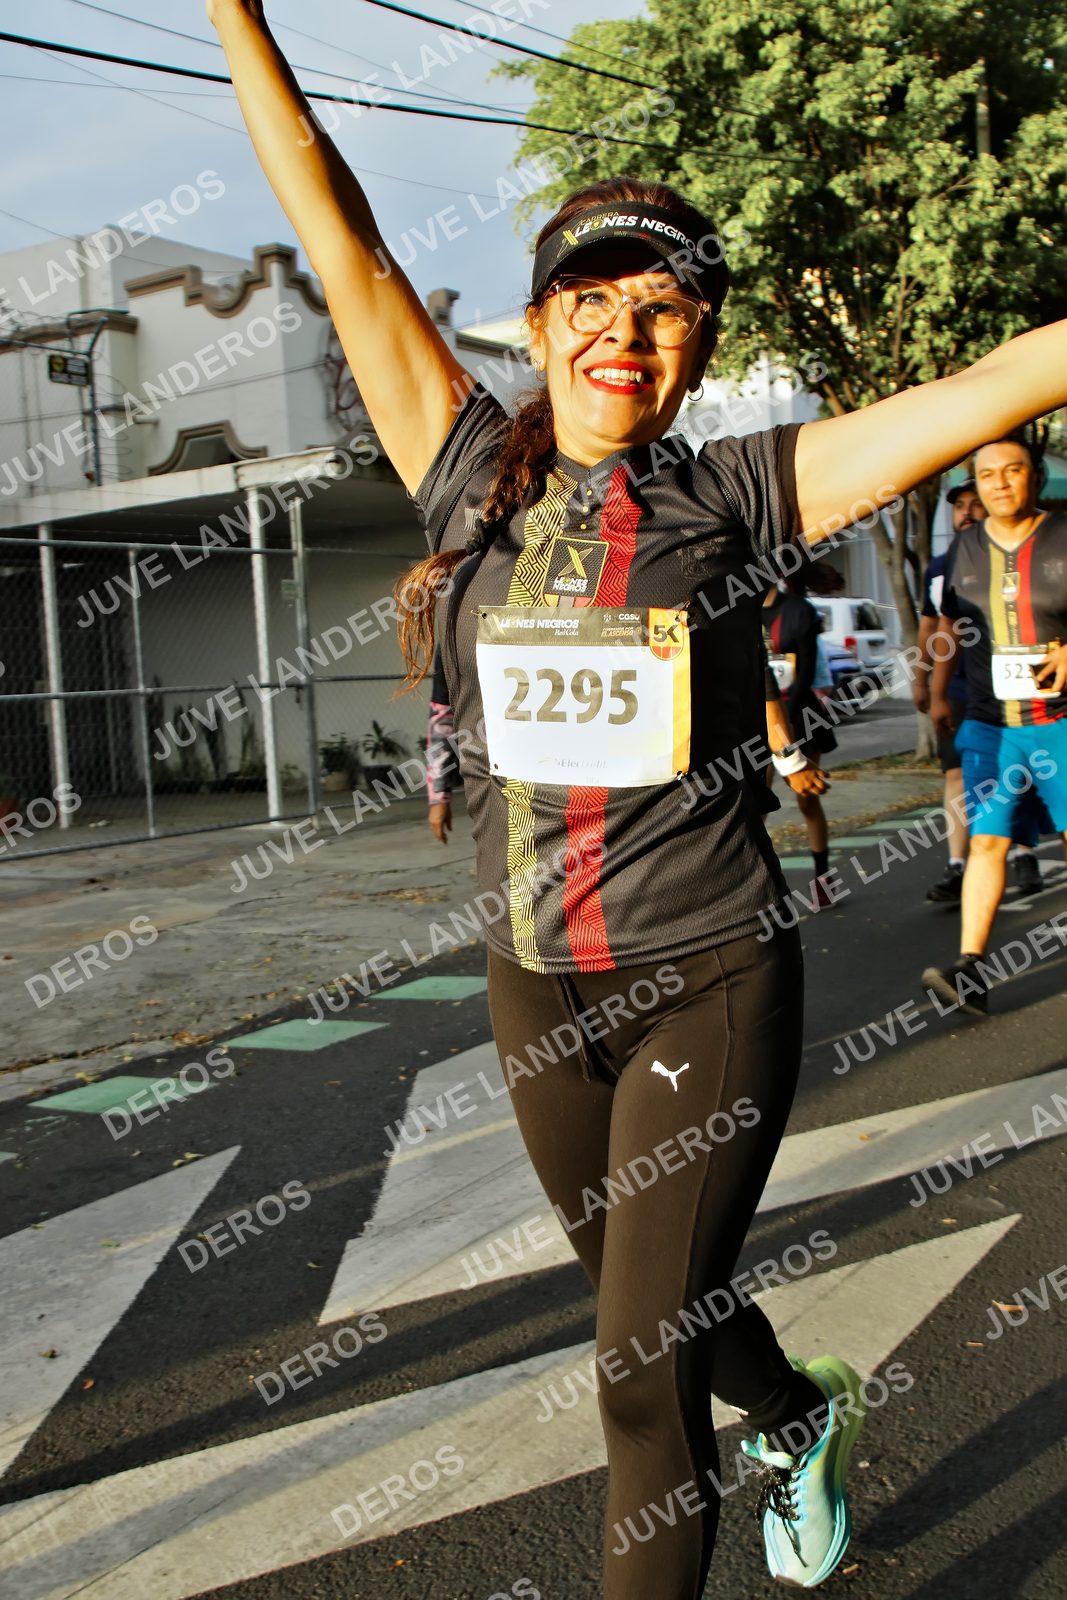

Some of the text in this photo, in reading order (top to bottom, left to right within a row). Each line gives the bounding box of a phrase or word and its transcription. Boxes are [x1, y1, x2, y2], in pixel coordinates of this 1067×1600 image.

[575, 215, 638, 237] LEONES
[537, 619, 579, 629] NEGROS
[653, 624, 679, 643] 5K
[503, 666, 638, 725] 2295
